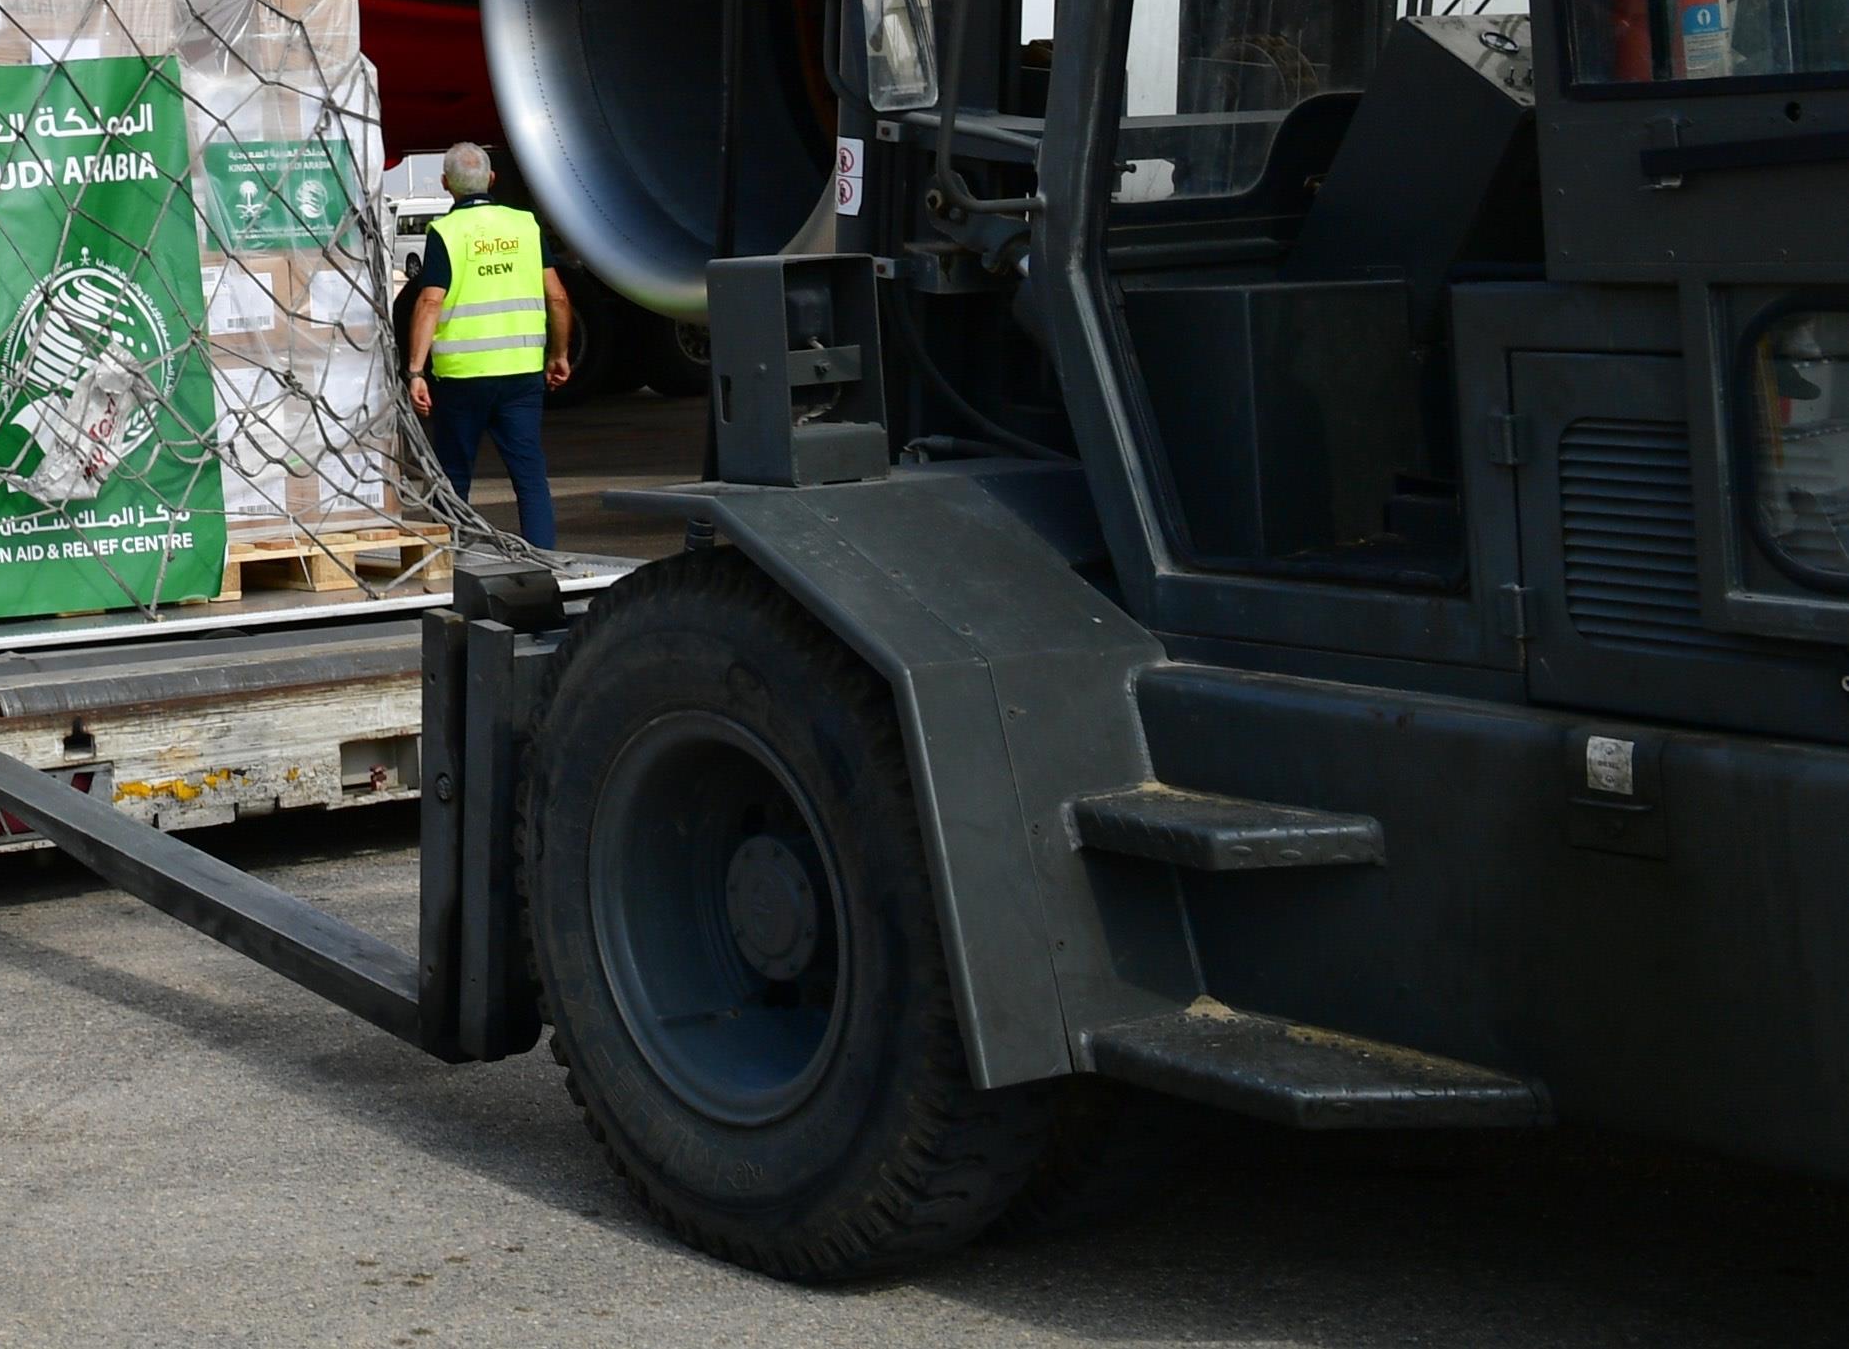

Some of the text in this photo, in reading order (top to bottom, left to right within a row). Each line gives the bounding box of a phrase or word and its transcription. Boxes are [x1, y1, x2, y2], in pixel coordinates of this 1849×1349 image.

[35, 103, 154, 138] المملكة
[62, 151, 159, 185] ARABIA
[477, 262, 513, 277] CREW
[15, 544, 44, 562] AID
[47, 542, 59, 560] &
[62, 538, 119, 558] RELIEF
[122, 532, 194, 553] CENTRE
